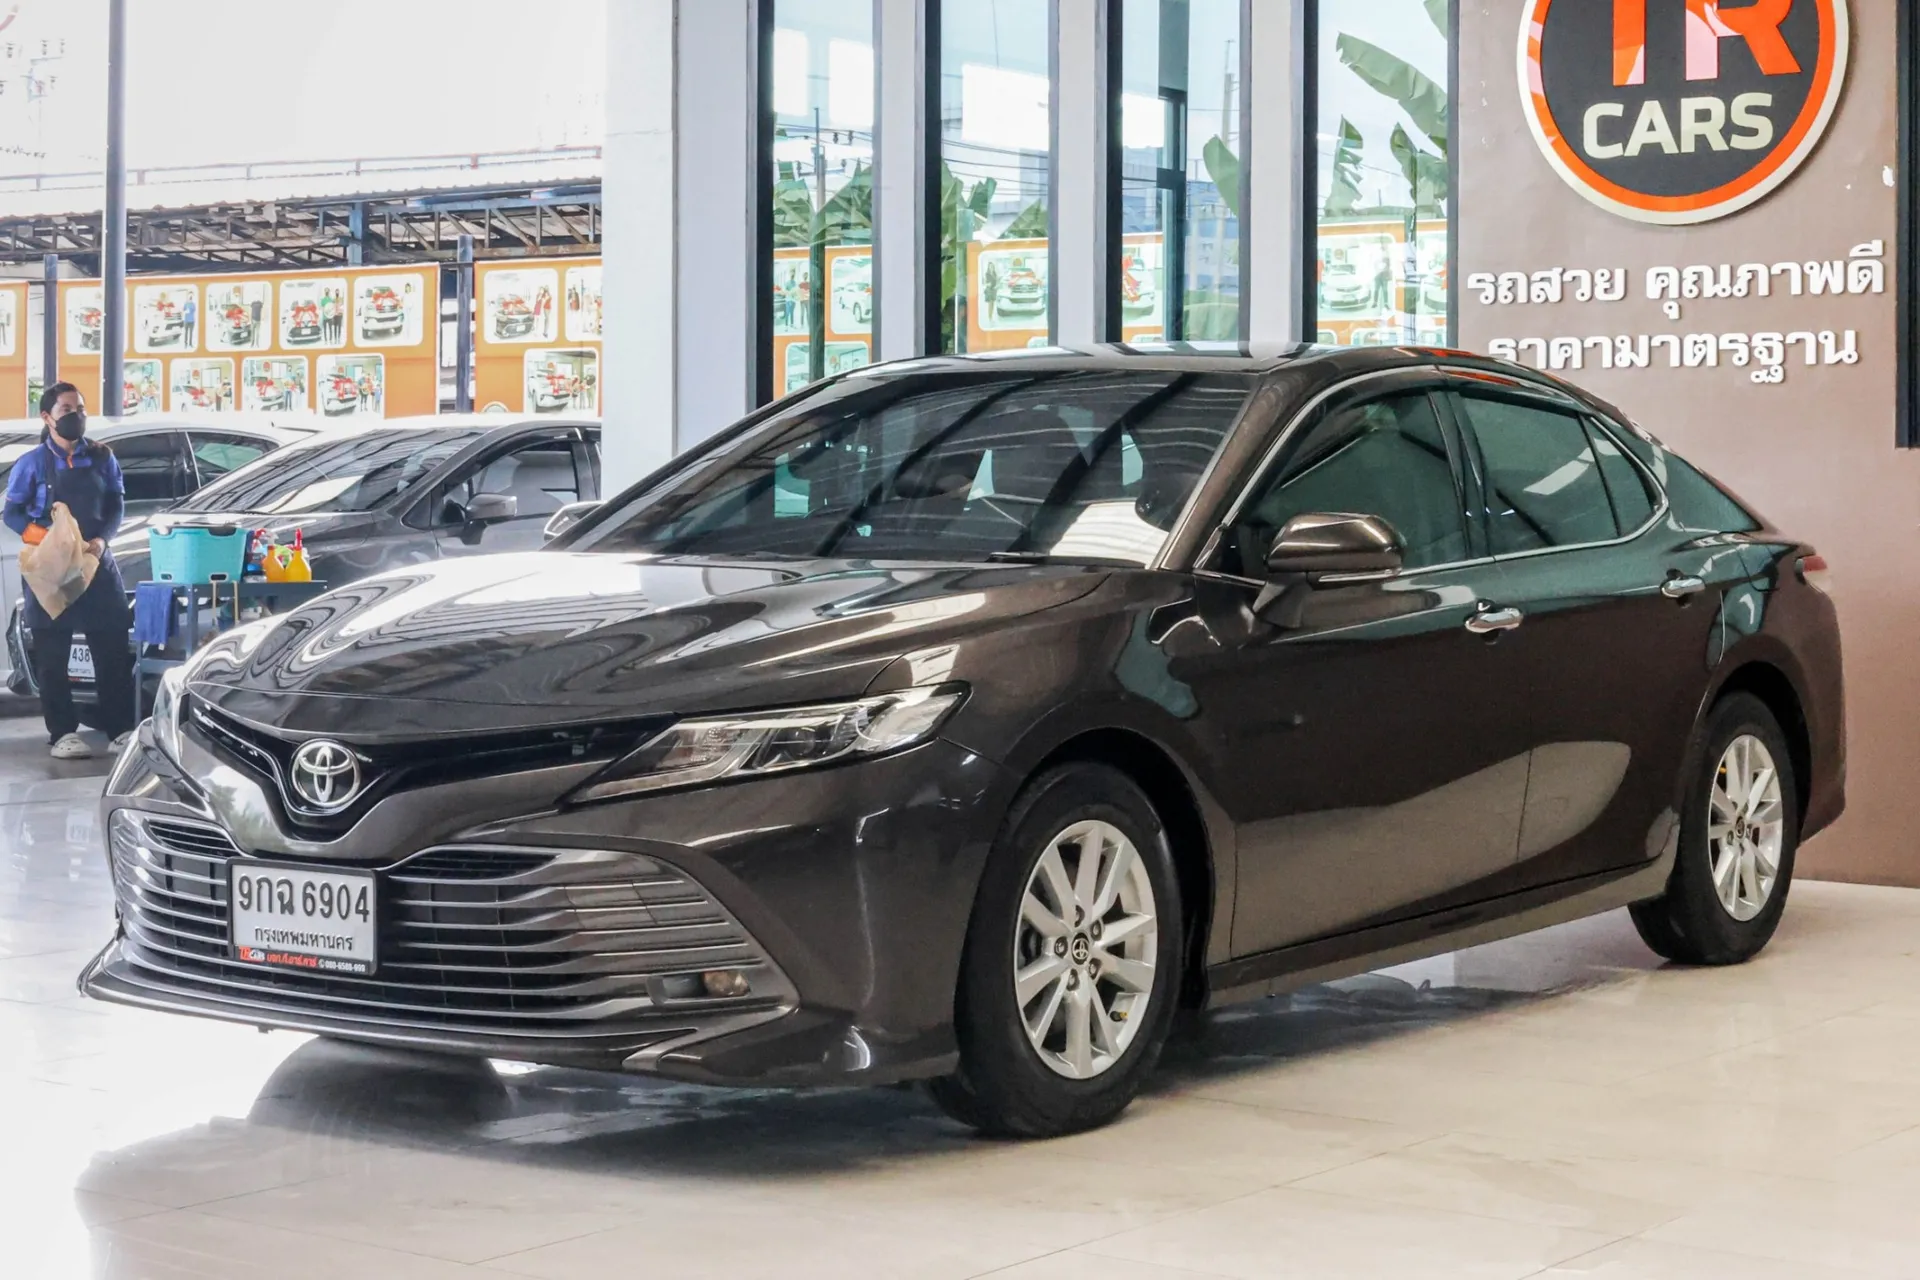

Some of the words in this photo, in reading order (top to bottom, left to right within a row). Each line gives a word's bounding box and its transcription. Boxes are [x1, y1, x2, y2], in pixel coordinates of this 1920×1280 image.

[1583, 92, 1774, 159] CARS
[1467, 266, 1626, 305] รถสวย
[1645, 239, 1884, 320] คุณภาพดี
[1488, 329, 1859, 383] ราคามาตรฐาน
[238, 874, 294, 915] 9กฉ
[302, 880, 370, 923] 6904
[254, 926, 353, 951] กรุงเทพมหานคร
